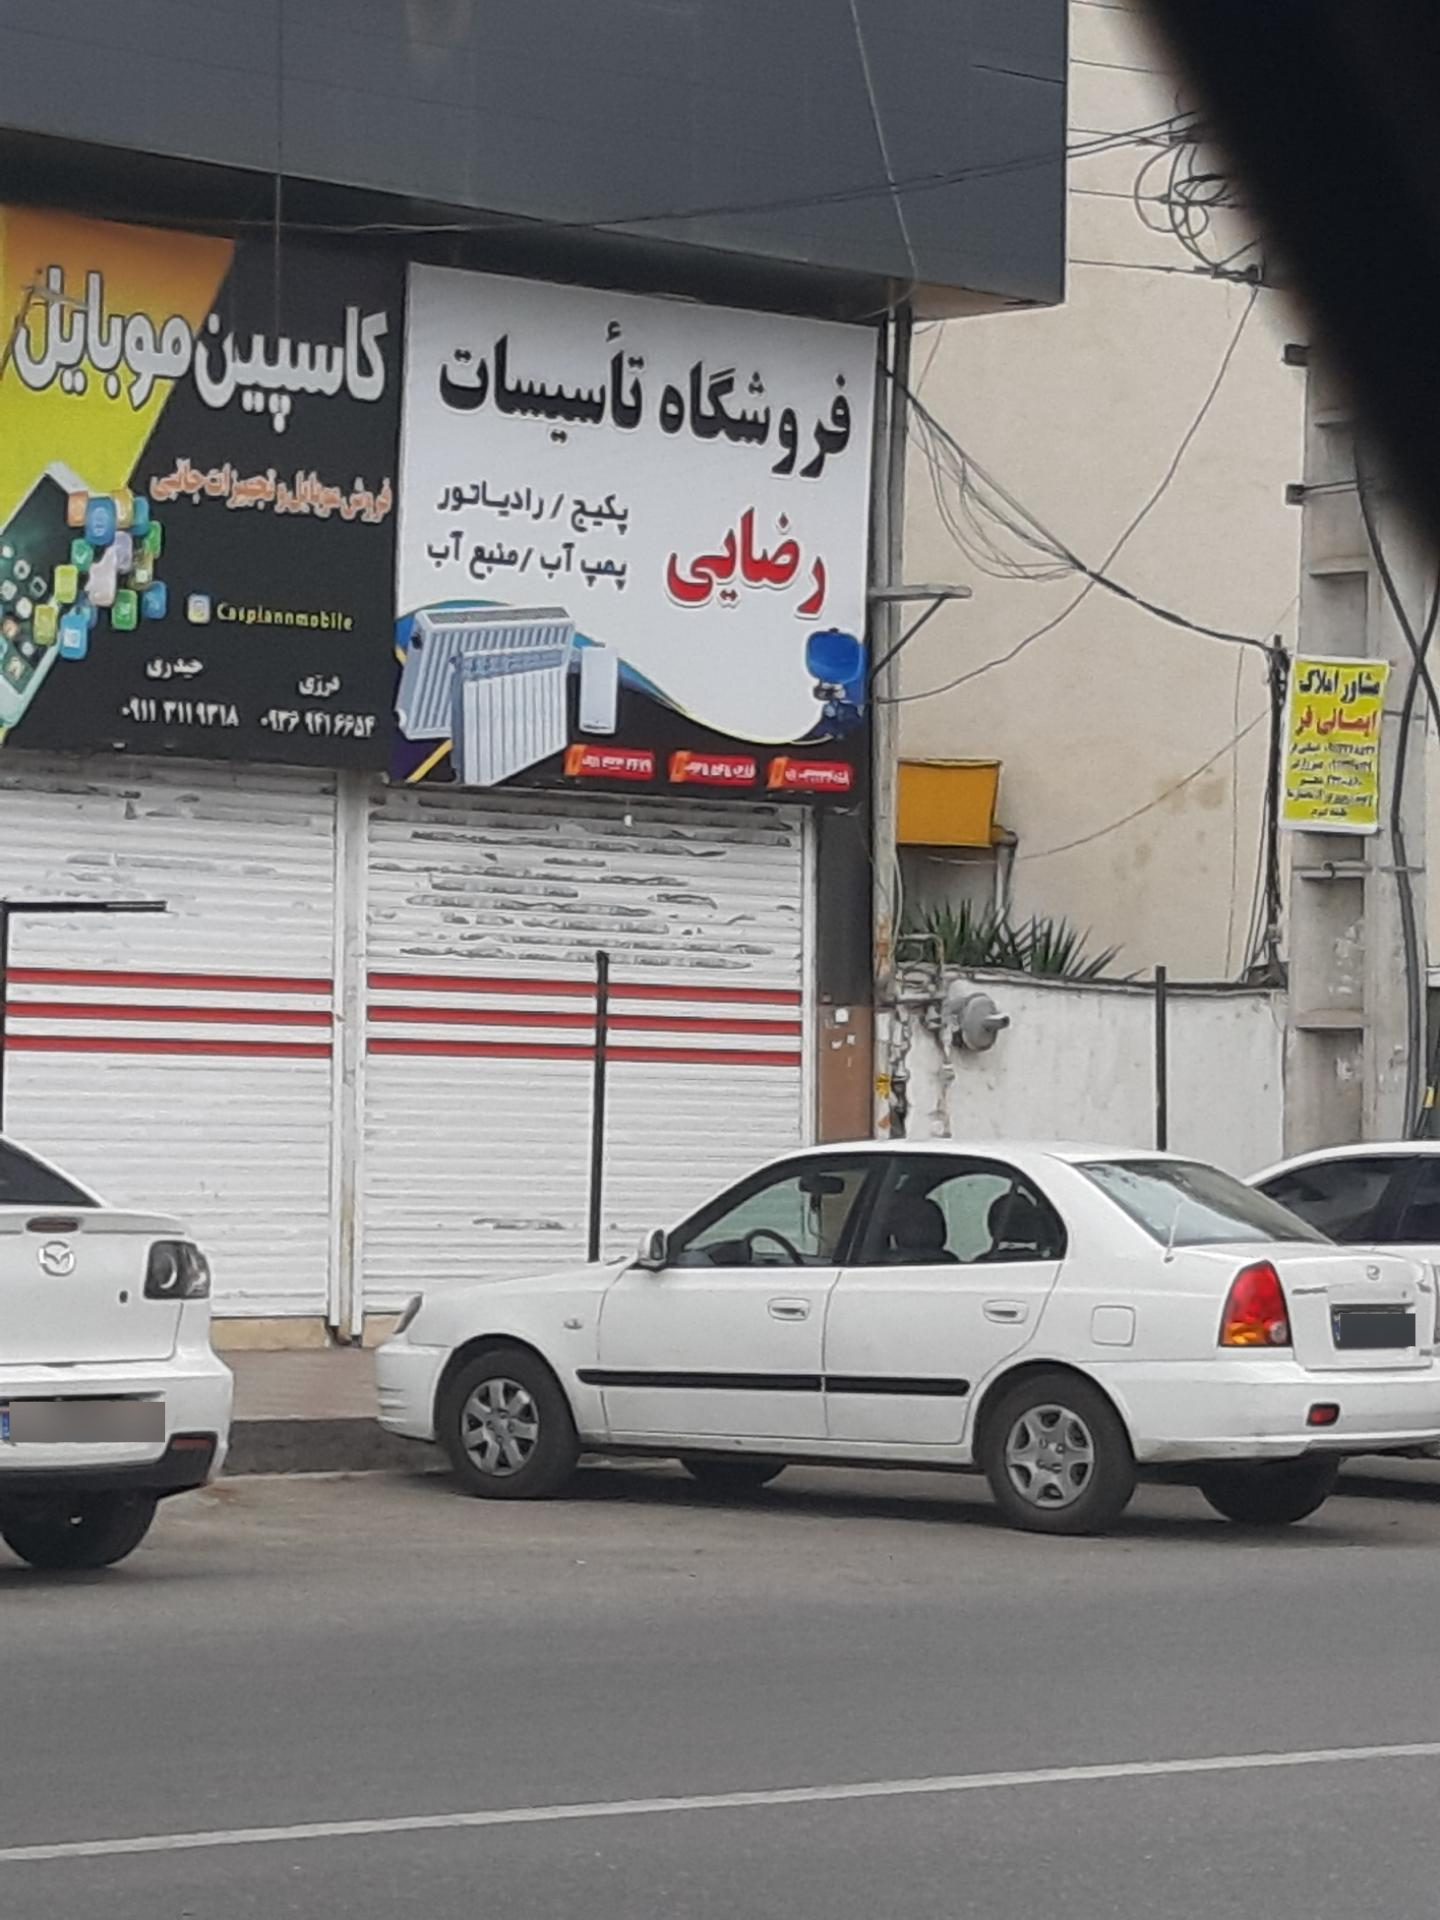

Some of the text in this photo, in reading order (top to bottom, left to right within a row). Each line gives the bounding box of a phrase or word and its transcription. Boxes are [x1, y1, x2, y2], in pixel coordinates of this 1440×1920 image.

[12, 266, 390, 433] کاسپین موبایل
[659, 359, 852, 478] فروشگاه
[437, 480, 545, 520] رادیاتور
[571, 493, 629, 536] پکیج
[427, 530, 464, 568] آب
[540, 542, 575, 579] آب
[666, 507, 827, 616] رضایی
[580, 558, 628, 591] پمپ
[1340, 672, 1380, 704] مشاور
